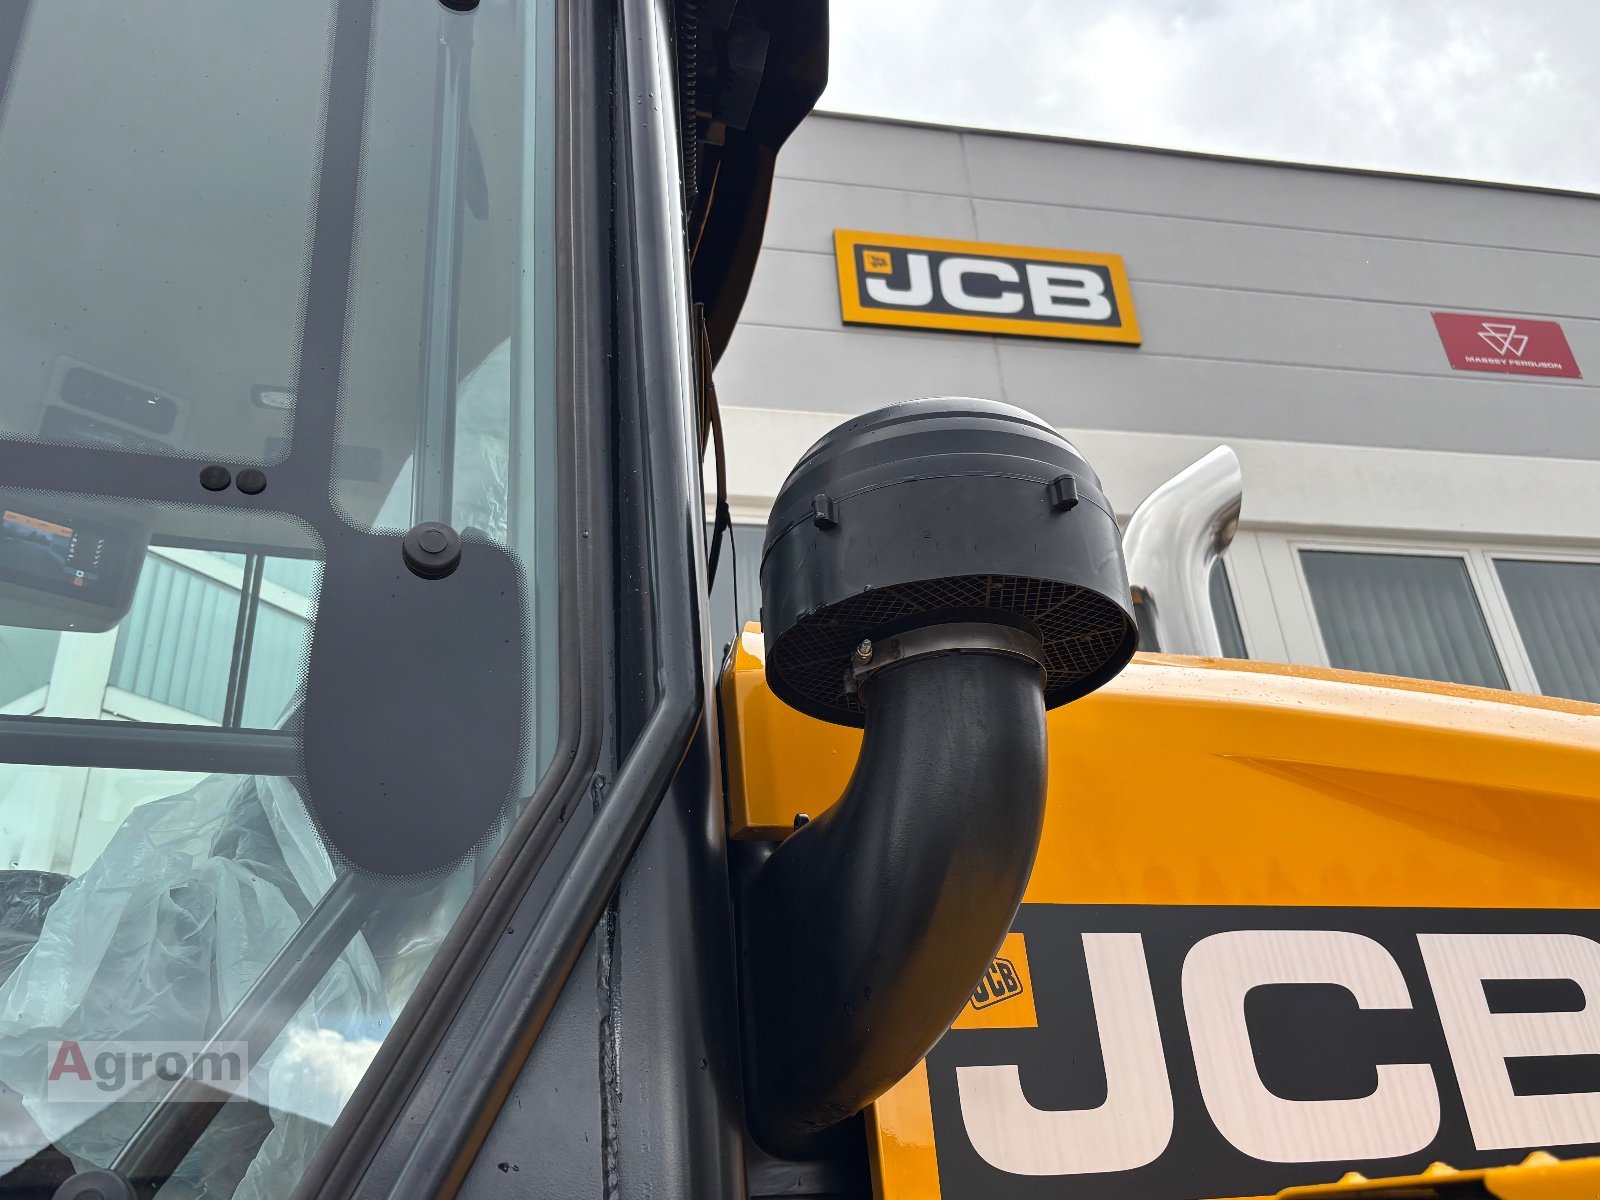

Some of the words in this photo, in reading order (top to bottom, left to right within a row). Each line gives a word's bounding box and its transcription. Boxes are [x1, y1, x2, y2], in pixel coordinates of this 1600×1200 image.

[865, 254, 1112, 320] JCB
[1464, 356, 1507, 365] MASSEY
[1508, 359, 1562, 369] FERGUSON
[955, 930, 1600, 1175] JCB
